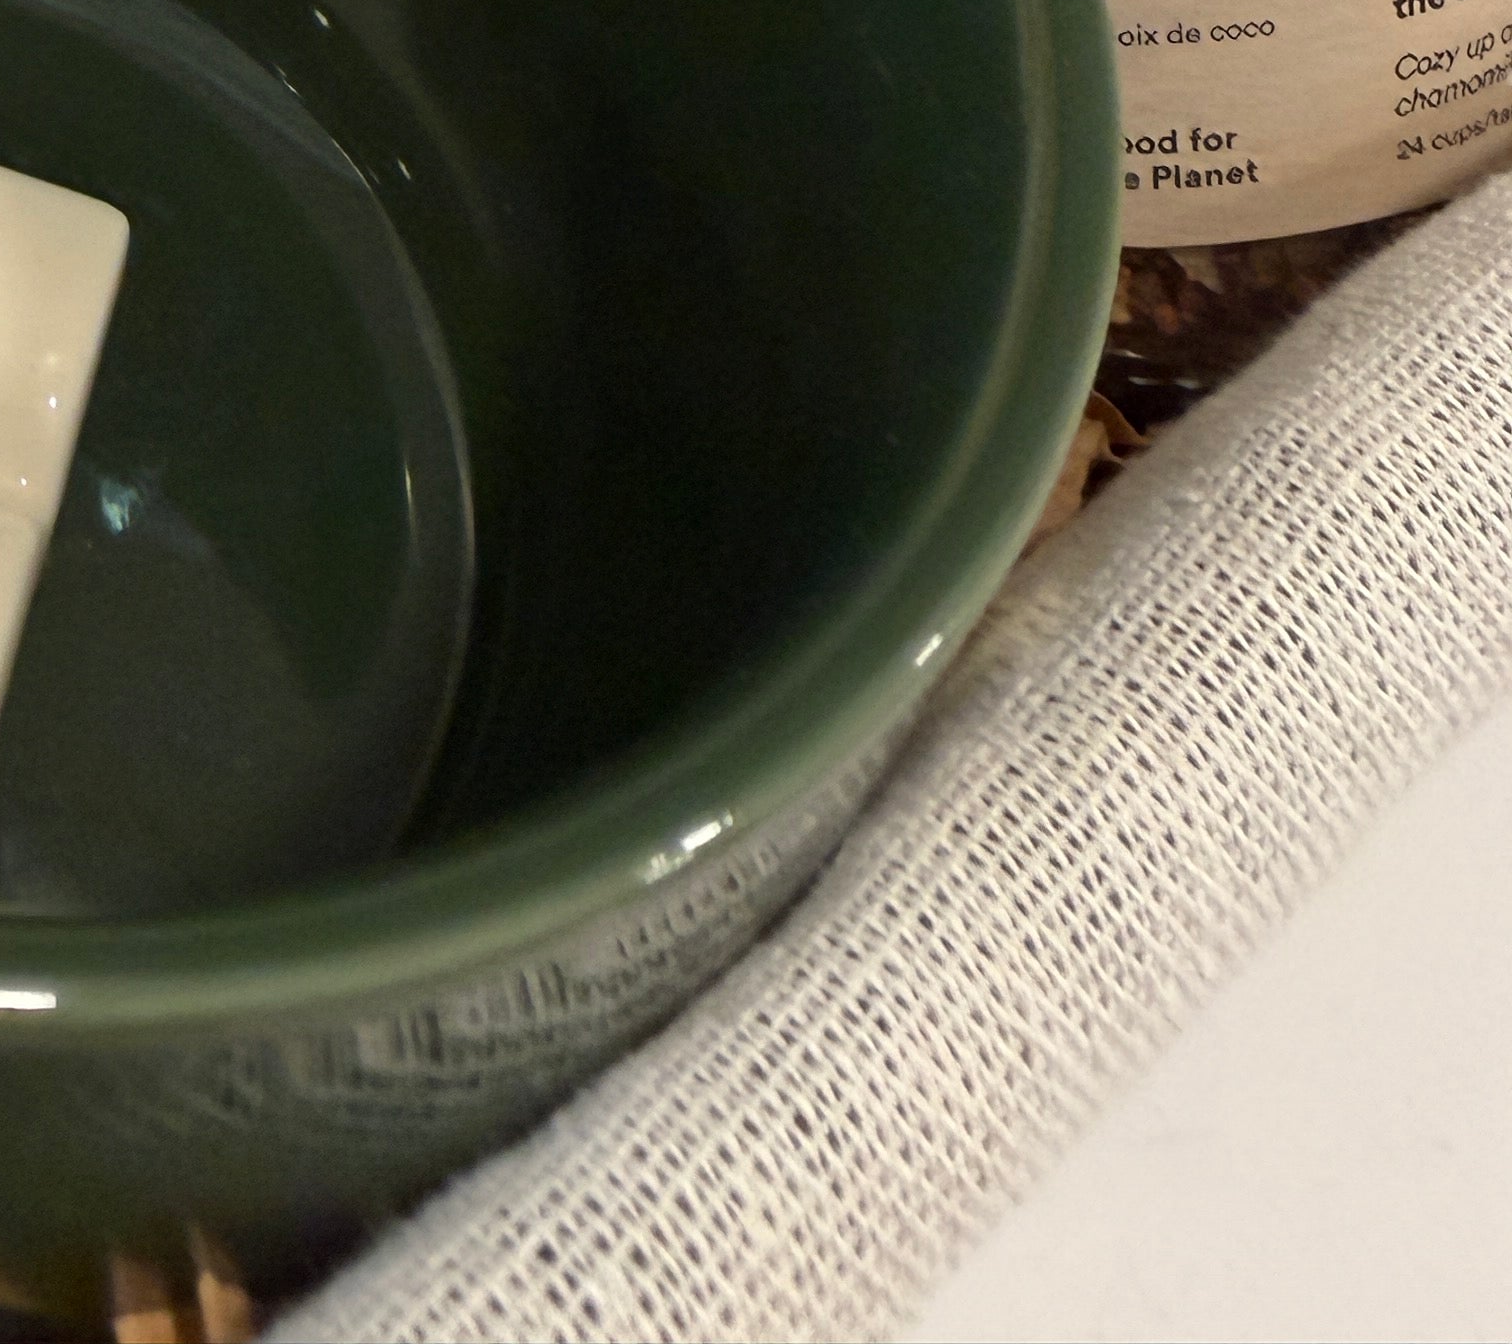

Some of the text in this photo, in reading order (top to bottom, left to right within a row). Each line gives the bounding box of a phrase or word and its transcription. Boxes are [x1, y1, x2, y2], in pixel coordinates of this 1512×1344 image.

[1166, 22, 1202, 44] de
[1210, 19, 1276, 43] coco
[1394, 44, 1460, 81] Cozy
[1466, 31, 1495, 61] up
[1189, 127, 1239, 153] for
[1151, 158, 1261, 190] Planet
